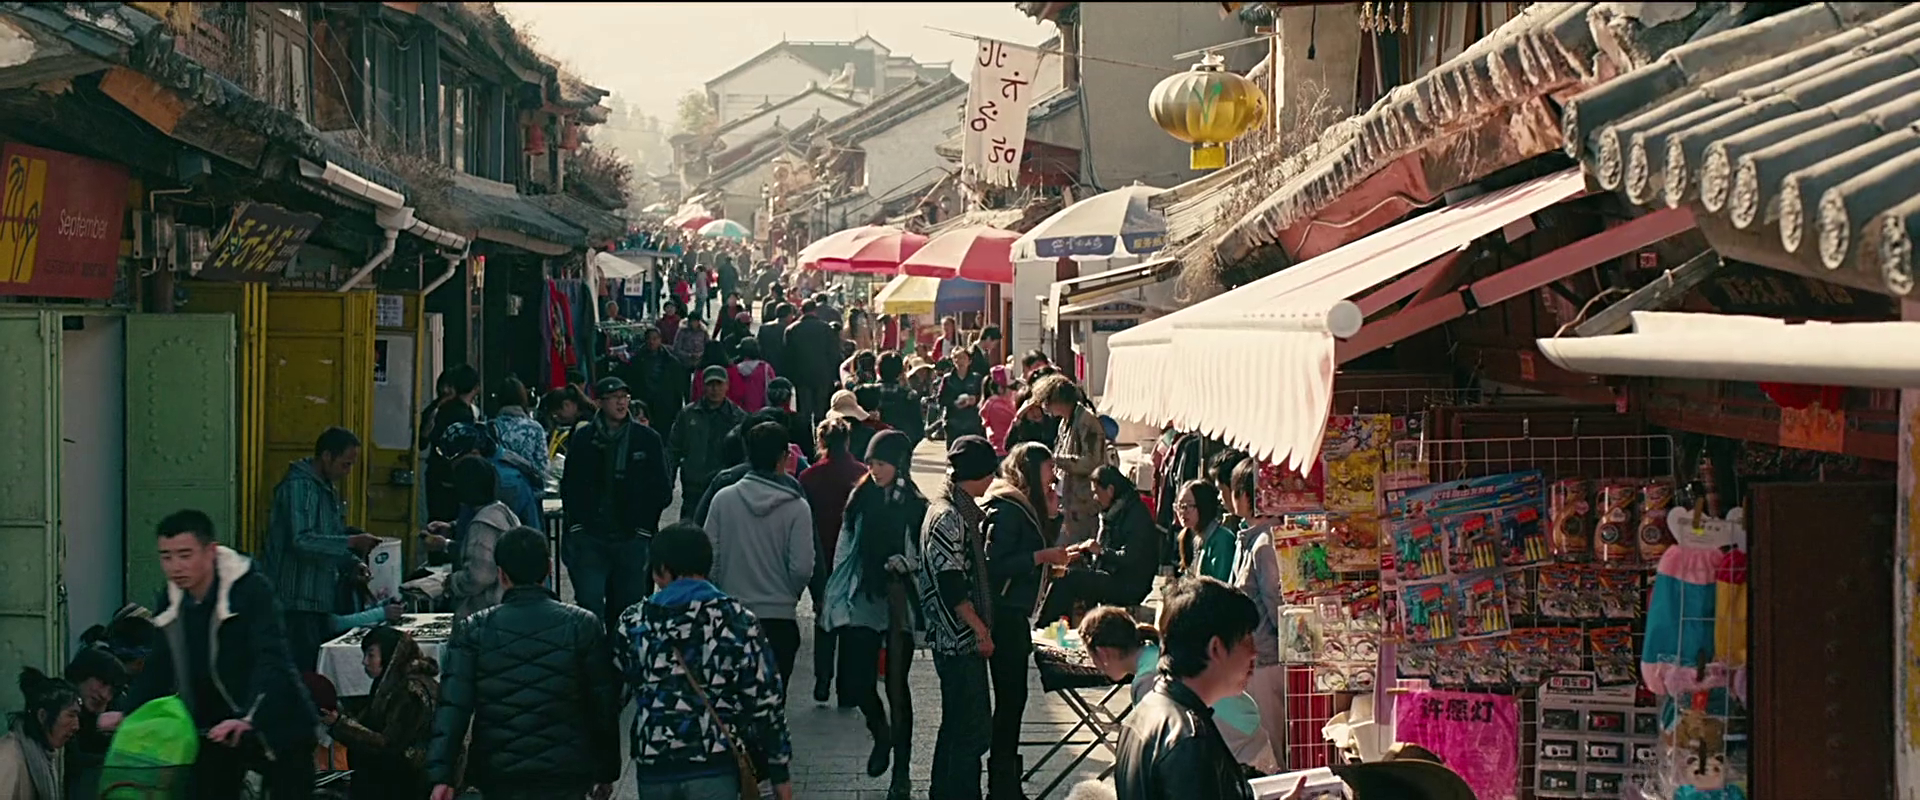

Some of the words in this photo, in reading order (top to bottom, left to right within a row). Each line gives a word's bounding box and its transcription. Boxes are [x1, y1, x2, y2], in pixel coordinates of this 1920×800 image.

[58, 208, 108, 241] September
[1421, 697, 1494, 722] 许愿灯
